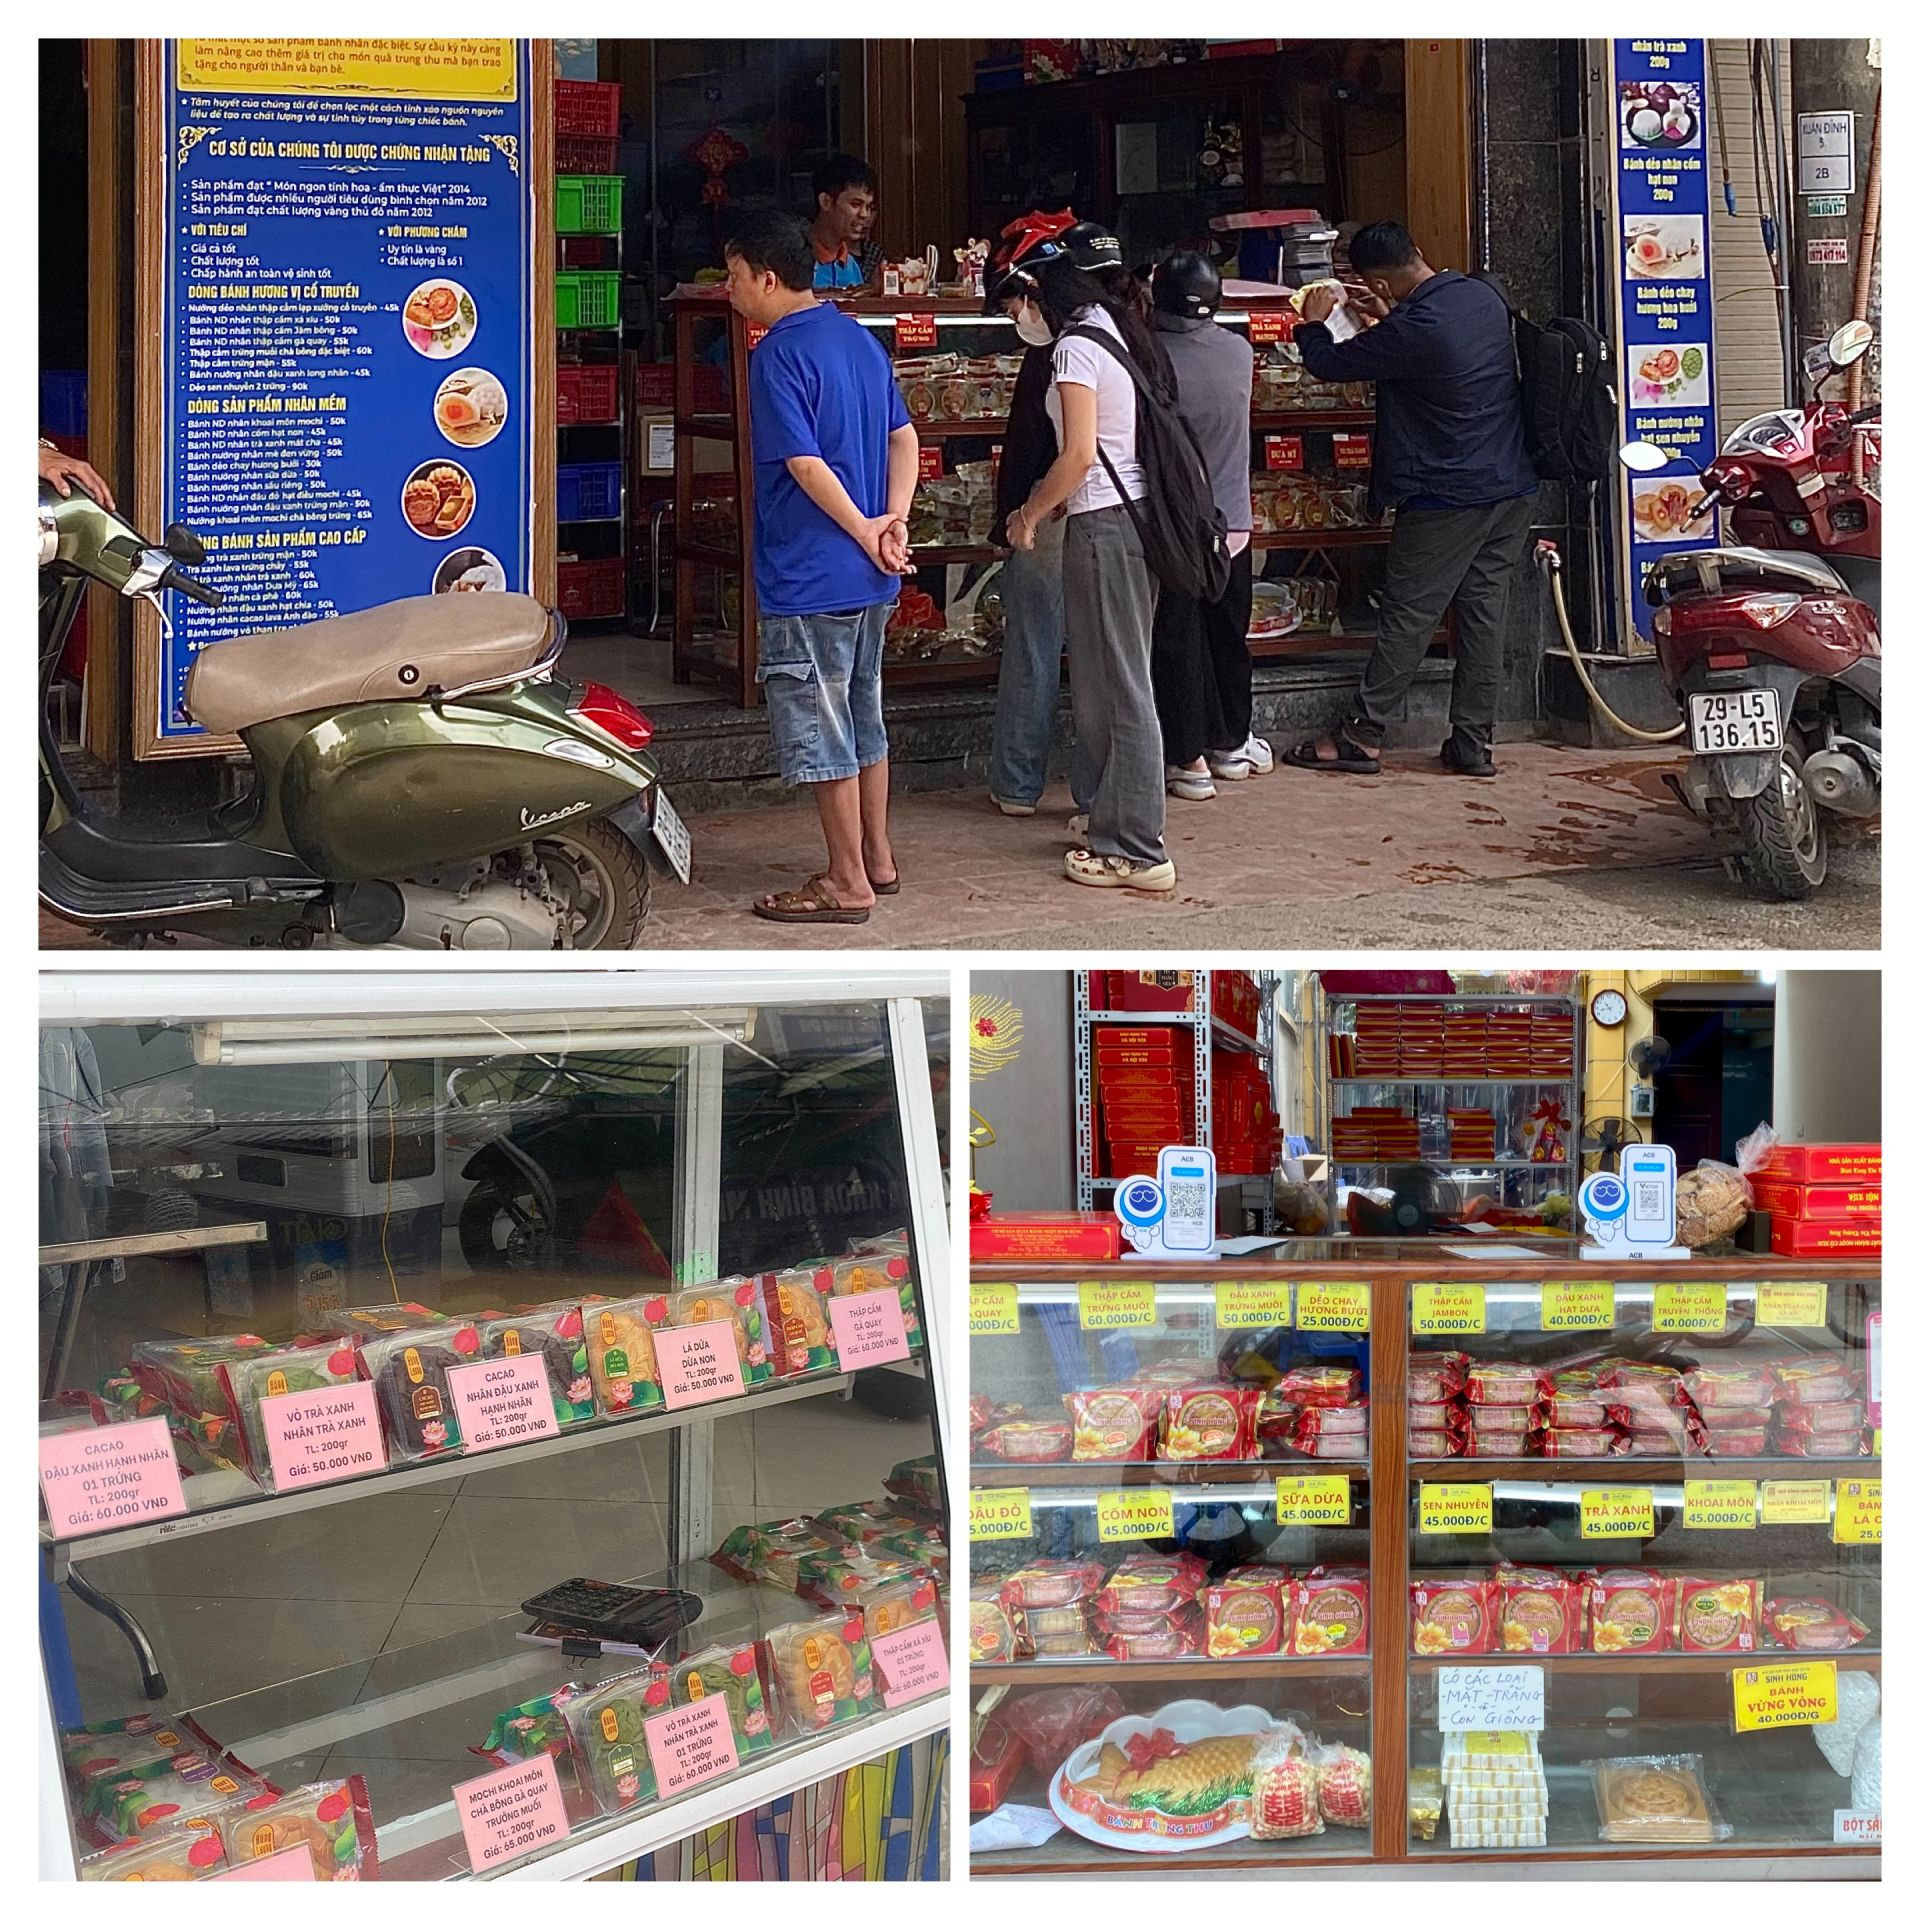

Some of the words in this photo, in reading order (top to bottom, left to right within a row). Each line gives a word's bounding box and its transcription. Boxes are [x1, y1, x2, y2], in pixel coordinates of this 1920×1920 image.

[209, 140, 227, 156] CƠ
[229, 137, 248, 156] SỞ
[250, 138, 275, 157] CỦA
[278, 140, 320, 158] CHÚNG
[323, 141, 342, 159] TÔI
[345, 144, 377, 162] ĐƯỢC
[381, 143, 421, 162] CHỨNG
[424, 144, 457, 164] NHẬN
[460, 145, 490, 165] TẶNG
[1815, 167, 1830, 179] 2B
[191, 205, 211, 215] Sản
[213, 204, 244, 216] phẩm
[246, 204, 264, 216] đạt
[266, 204, 290, 215] chất
[292, 205, 321, 217] lượng
[324, 207, 349, 218] vàng
[351, 206, 369, 216] thủ
[371, 208, 385, 217] đô
[387, 208, 409, 217] năm
[411, 208, 433, 217] 2012
[188, 284, 218, 299] DÒNG
[220, 284, 249, 299] BÁNH
[252, 285, 288, 299] HƯƠNG
[290, 285, 301, 301] VỊ
[303, 281, 318, 298] CỔ
[320, 281, 359, 299] TRUYỀN
[188, 397, 219, 414] DÒNG
[222, 395, 246, 412] SẢN
[249, 393, 282, 412] PHẨM
[285, 396, 316, 412] NHÂN
[319, 392, 347, 411] MỀM
[1703, 695, 1765, 721] 29-L5
[1700, 721, 1775, 750] 136.15
[521, 801, 592, 831] Vespa
[1180, 1155, 1195, 1163] ACB
[1628, 1252, 1644, 1260] ACB
[1093, 1291, 1119, 1302] THẬP
[1332, 1297, 1359, 1306] CHAY
[1429, 1297, 1451, 1307] THẬP
[1670, 1296, 1692, 1306] THẬP
[1087, 1303, 1121, 1314] TRỨNG
[1123, 1300, 1150, 1311] MUỐI
[1300, 1305, 1338, 1315] HƯƠNG
[1432, 1308, 1469, 1318] JAMBON
[1658, 1305, 1690, 1316] TRUYỀN
[1087, 1313, 1151, 1326] 60.000Đ/C
[1302, 1316, 1365, 1327] 25.000Đ/C
[1420, 1318, 1481, 1330] 50.000Đ/C
[1660, 1317, 1720, 1329] 40.000Đ/C
[682, 1342, 694, 1354] LÁ
[693, 1337, 711, 1351] DỨA
[682, 1355, 700, 1369] DỪA
[700, 1354, 717, 1366] NON
[485, 1368, 515, 1382] CACAO
[685, 1370, 697, 1379] TL:
[697, 1366, 717, 1377] 200gr
[466, 1388, 493, 1403] NHÂN
[494, 1384, 514, 1400] ĐẬU
[515, 1379, 540, 1394] XANH
[674, 1382, 691, 1395] Giá:
[691, 1377, 718, 1390] 50.000
[718, 1374, 735, 1385] VNĐ
[286, 1408, 301, 1423] VỎ
[304, 1405, 325, 1420] TRÀ
[326, 1402, 356, 1417] XANH
[480, 1402, 507, 1419] HẠNH
[506, 1395, 533, 1411] NHÂN
[489, 1416, 503, 1427] TL:
[504, 1411, 528, 1423] 200gr
[283, 1424, 315, 1441] NHÂN
[316, 1420, 337, 1436] TRÀ
[337, 1416, 367, 1431] XANH
[474, 1429, 495, 1444] Giá:
[495, 1424, 527, 1440] 50.000
[528, 1419, 548, 1432] VNĐ
[84, 1441, 124, 1455] CACAO
[305, 1445, 320, 1455] TL:
[321, 1439, 349, 1453] 200gr
[72, 1460, 104, 1476] XANH
[106, 1455, 138, 1470] HẠNH
[138, 1448, 169, 1464] NHÂN
[289, 1462, 311, 1477] Giá:
[312, 1456, 349, 1473] 50.000
[350, 1451, 373, 1464] VNĐ
[82, 1479, 99, 1492] 01
[101, 1470, 143, 1488] TRỨNG
[88, 1495, 105, 1505] TL:
[107, 1488, 140, 1502] 200gr
[1282, 1492, 1310, 1506] SỮA
[1313, 1491, 1344, 1505] DỪA
[1423, 1501, 1443, 1510] SEN
[1445, 1497, 1489, 1510] NHUYỄN
[1687, 1497, 1725, 1508] KHOAI
[1728, 1495, 1755, 1508] MÔN
[68, 1510, 95, 1525] Giá:
[96, 1502, 140, 1520] 60.000
[142, 1496, 169, 1511] VNĐ
[1101, 1507, 1133, 1521] CỐM
[1136, 1506, 1169, 1518] NON
[1281, 1508, 1345, 1520] 45.000Đ/C
[1584, 1504, 1610, 1517] TRÀ
[1612, 1504, 1651, 1516] XANH
[1688, 1512, 1753, 1524] 45.000Đ/C
[1103, 1520, 1169, 1536] 45.000Đ/C
[1424, 1515, 1488, 1527] 45.000Đ/C
[1586, 1520, 1651, 1534] 45.000Đ/C
[1442, 1668, 1460, 1685] CÓ
[1464, 1668, 1492, 1685] CÁC
[1765, 1674, 1784, 1684] SINH
[1769, 1686, 1805, 1697] BÁNH
[1747, 1698, 1785, 1713] VỪNG
[1789, 1695, 1827, 1709] VÒNG
[1484, 1706, 1542, 1725] GIỐNG
[469, 1786, 498, 1804] MOCHI
[498, 1774, 524, 1793] KHOAI
[524, 1769, 544, 1783] MÔN
[470, 1802, 489, 1819] CHÀ
[489, 1796, 514, 1812] BÔNG
[514, 1789, 527, 1803] GÀ
[527, 1783, 549, 1798] QUAY
[520, 1797, 542, 1816] MUỐI
[496, 1828, 511, 1840] TL:
[511, 1819, 535, 1835] 200gr
[1106, 1814, 1143, 1830] BÁNH
[1144, 1815, 1184, 1835] TRUNG
[1187, 1819, 1213, 1833] THU
[1843, 1817, 1865, 1835] BỘT
[483, 1844, 503, 1859] Giá:
[504, 1832, 535, 1851] 65.000
[536, 1823, 556, 1838] VNĐ
